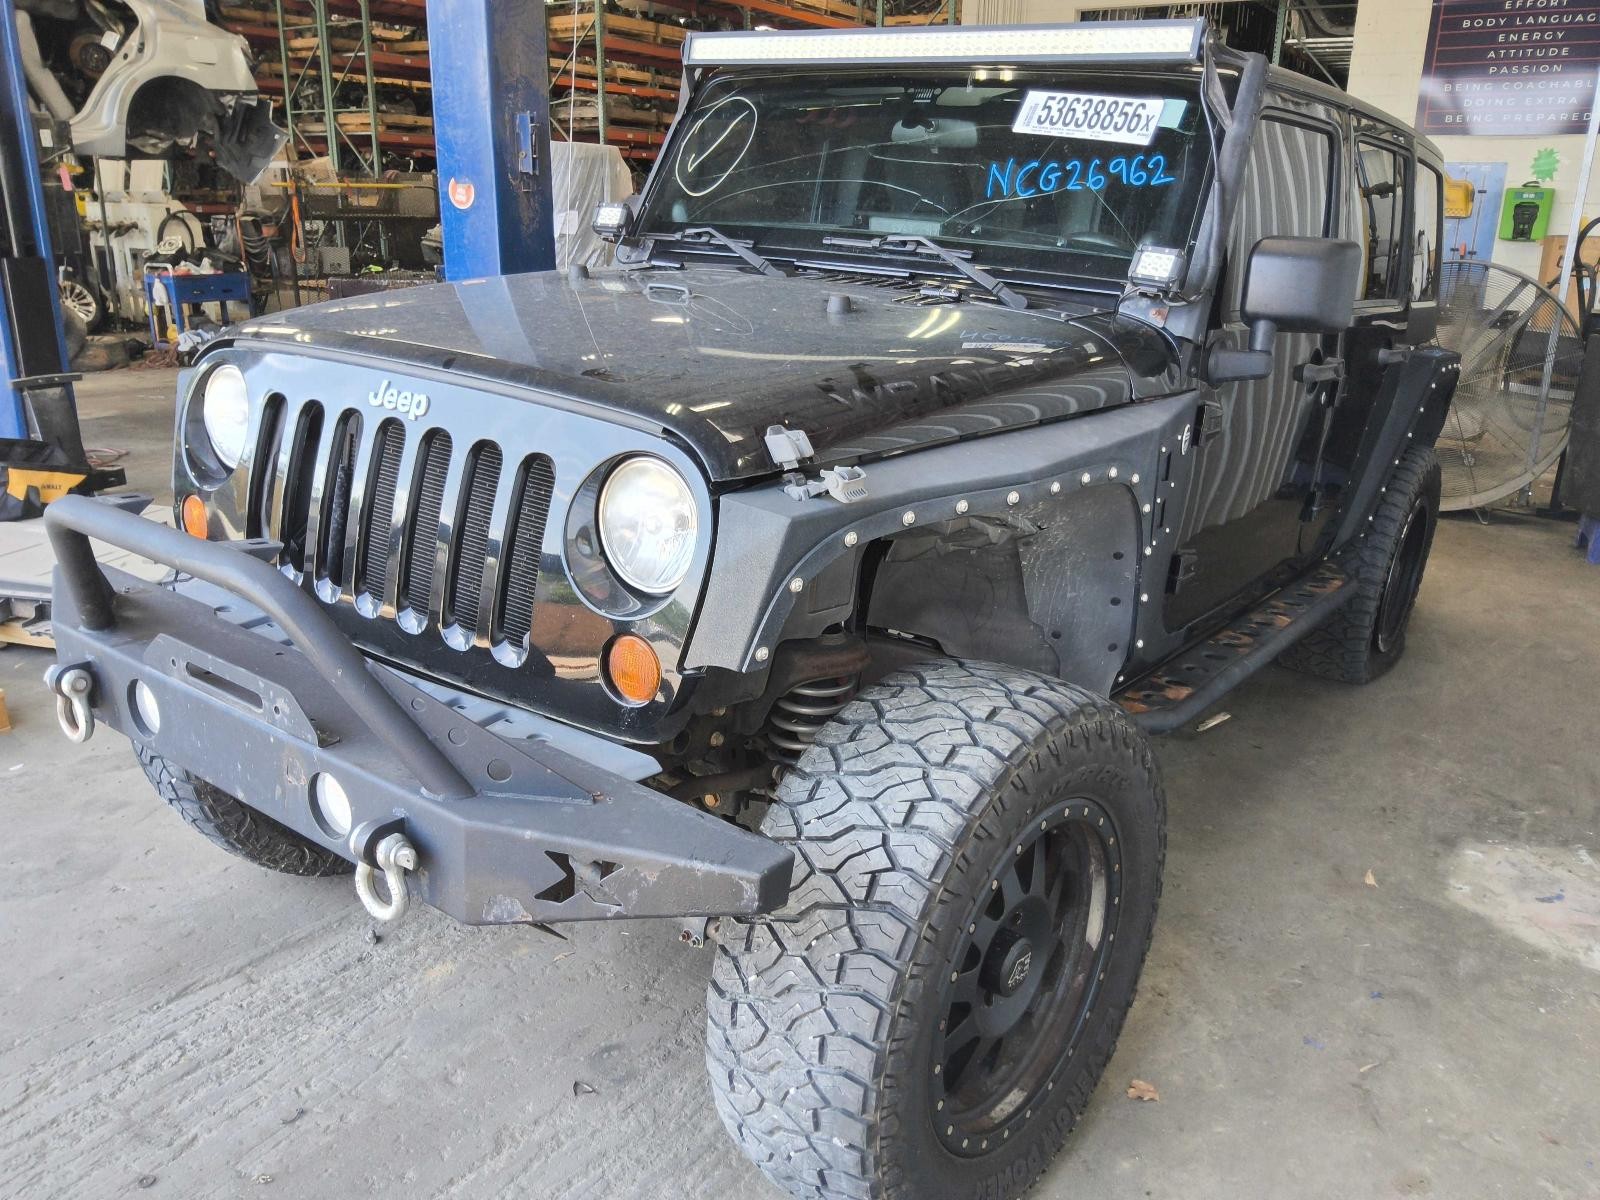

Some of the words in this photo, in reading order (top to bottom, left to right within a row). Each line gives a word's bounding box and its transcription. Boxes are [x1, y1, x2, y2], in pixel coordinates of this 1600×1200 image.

[1505, 0, 1567, 9] EFFORT
[1462, 17, 1507, 28] BODY
[1516, 13, 1600, 25] LANGUAG
[1498, 31, 1565, 43] ENERGY
[1487, 47, 1570, 59] ATTITUDE
[1489, 64, 1562, 75] PASSION
[1444, 82, 1493, 93] BEING
[1502, 79, 1594, 90] COACHABL
[1463, 97, 1517, 107] DOING
[1525, 96, 1578, 105] EXTRA
[1445, 113, 1493, 123] BEING
[1503, 112, 1592, 122] PREPARED
[986, 154, 1176, 198] NCG26962
[368, 379, 431, 421] Jeep
